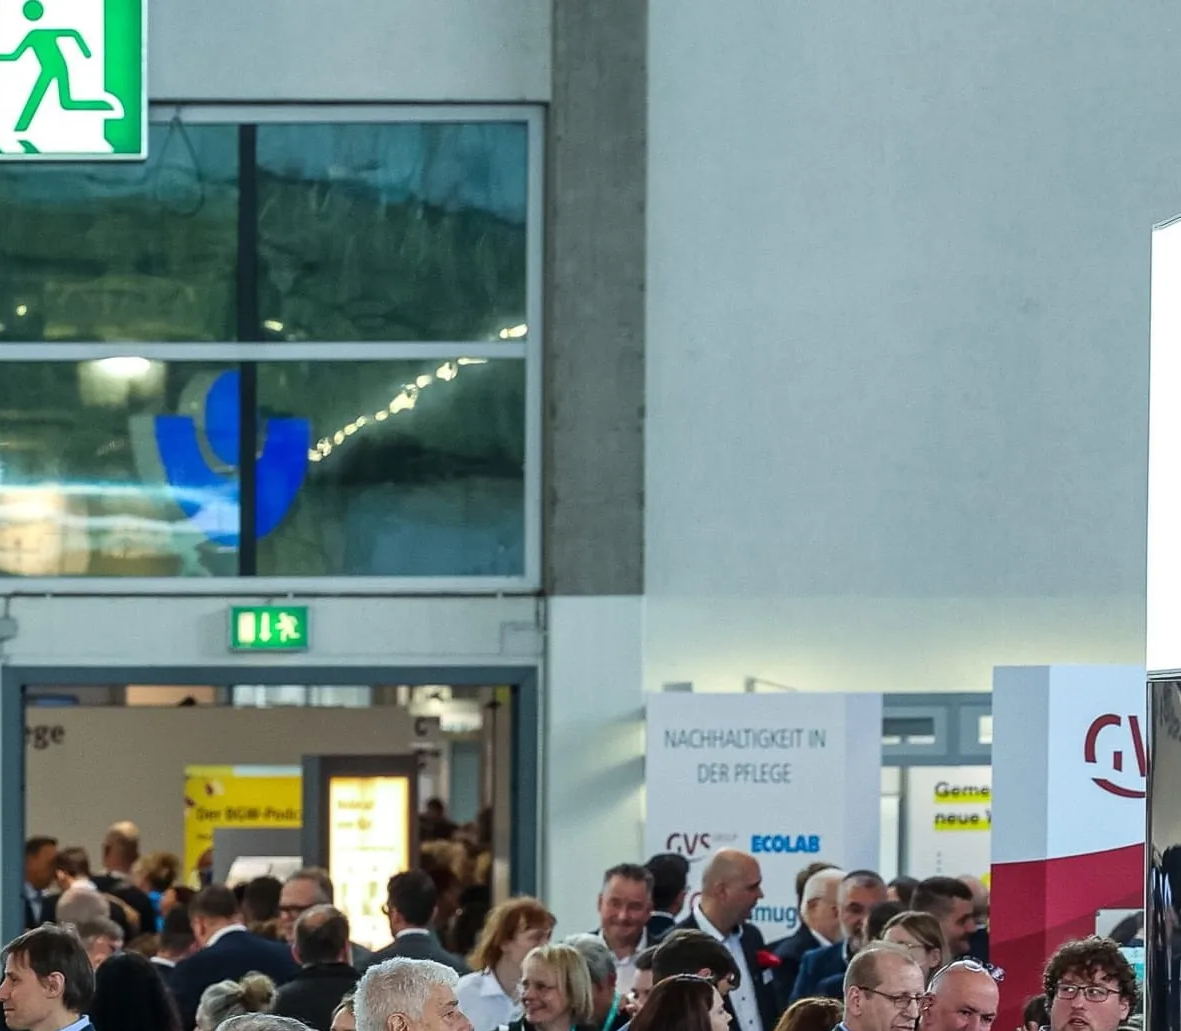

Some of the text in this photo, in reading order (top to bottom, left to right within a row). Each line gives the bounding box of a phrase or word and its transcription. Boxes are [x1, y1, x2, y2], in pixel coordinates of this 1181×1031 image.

[664, 729, 826, 749] NACHHALTIGKEIT IN
[697, 763, 792, 784] DER PFLEGE
[934, 781, 990, 798] Geme
[934, 812, 980, 827] neue
[750, 834, 821, 853] ECOLAB
